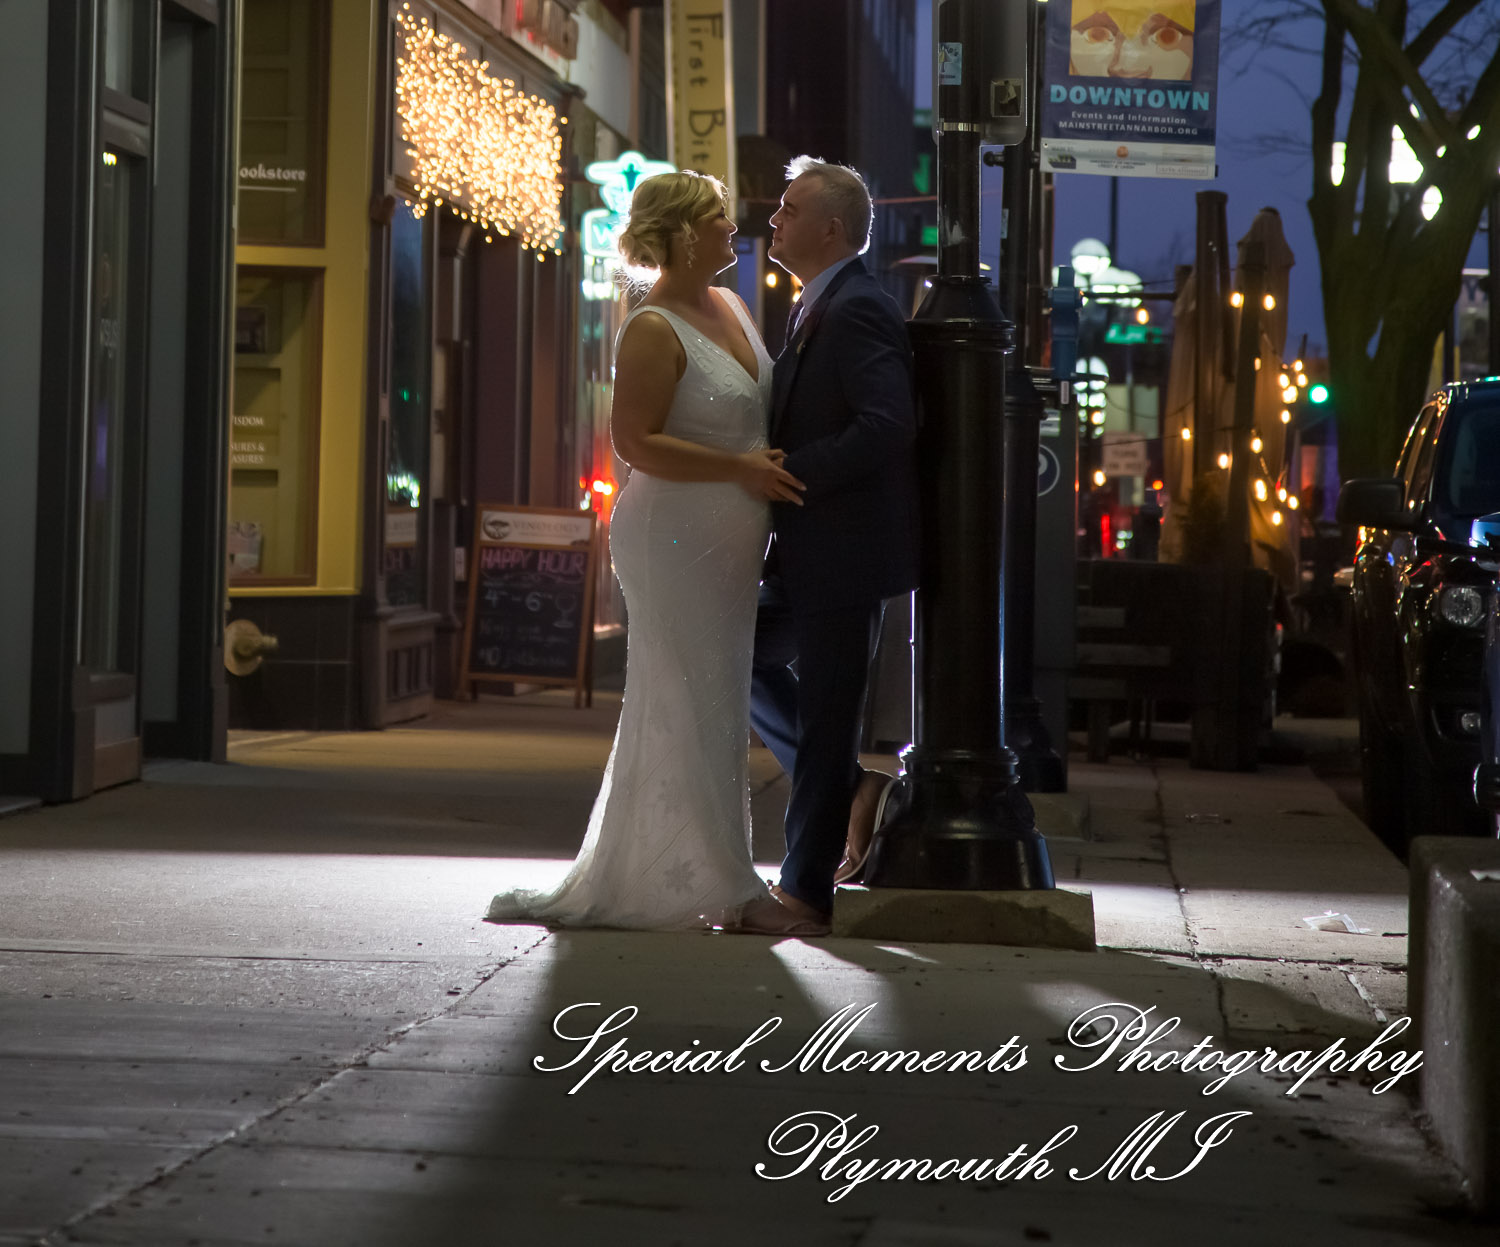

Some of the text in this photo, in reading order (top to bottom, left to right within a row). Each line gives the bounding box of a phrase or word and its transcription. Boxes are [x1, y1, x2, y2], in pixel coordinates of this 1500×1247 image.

[686, 12, 724, 87] First
[1050, 84, 1209, 111] DOWNTOWN
[1071, 111, 1187, 124] Events and Information
[1058, 120, 1199, 136] MAINSTREETANNARBOR.ORG
[240, 163, 306, 181] ookstore
[232, 415, 264, 426] ISDOM
[481, 547, 585, 575] HAPPY HOUR
